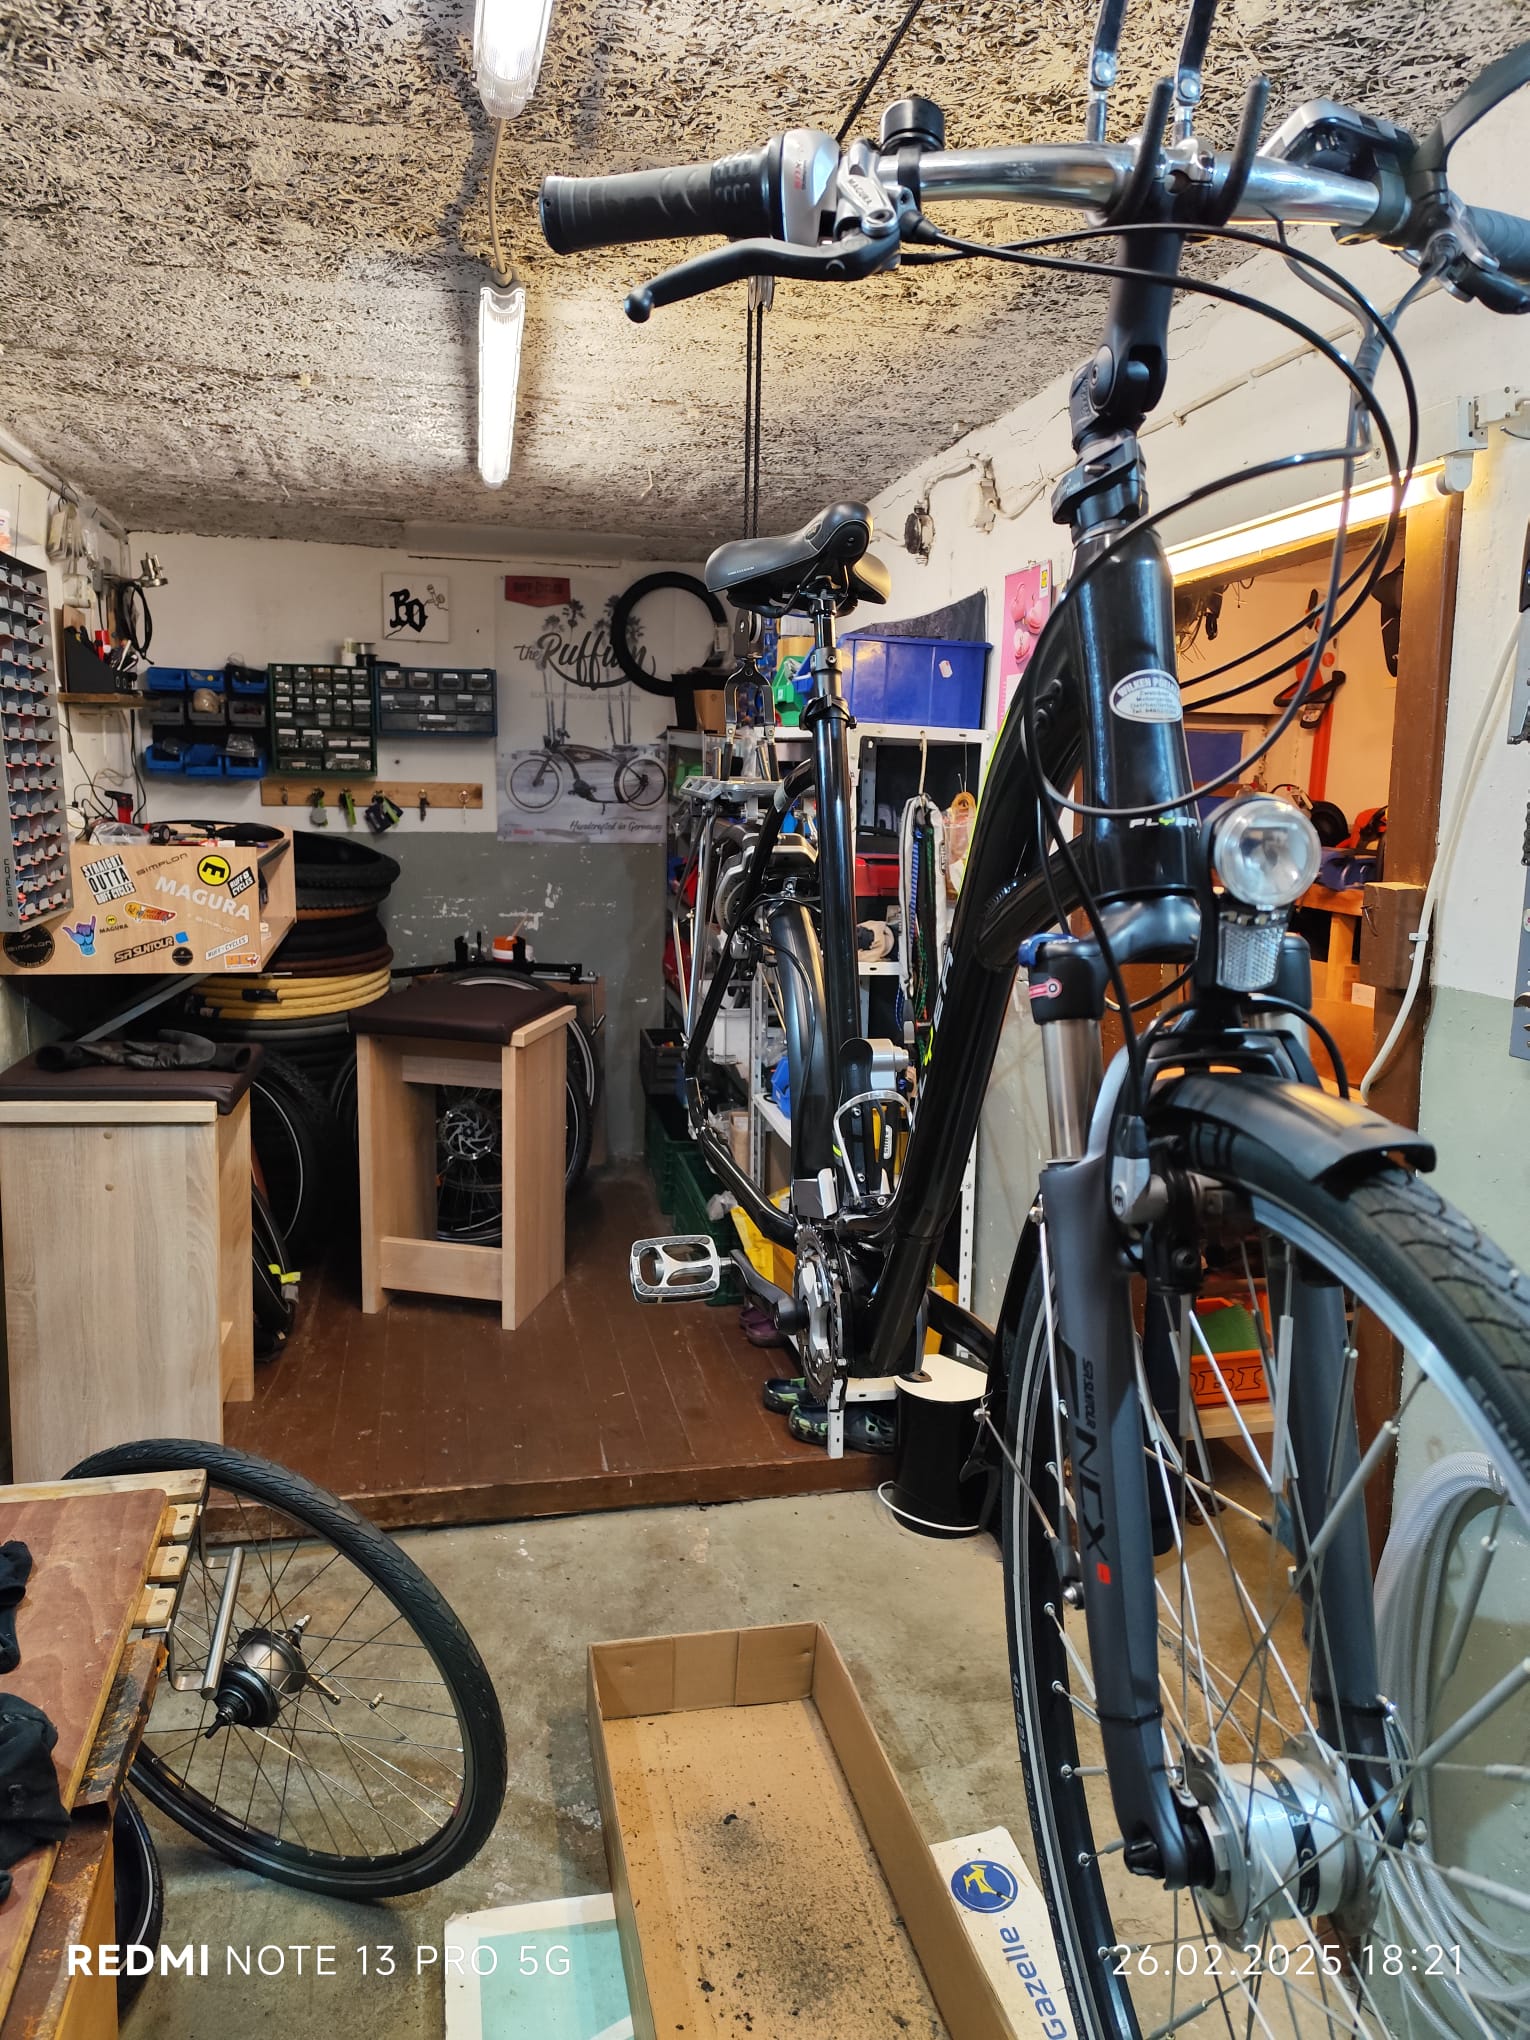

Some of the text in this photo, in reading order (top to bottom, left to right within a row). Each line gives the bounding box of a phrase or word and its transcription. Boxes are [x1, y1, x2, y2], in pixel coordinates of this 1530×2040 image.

[847, 178, 873, 206] MAGURA
[81, 854, 124, 877] STRAIGHT
[136, 852, 188, 877] SIMPLON
[3, 858, 13, 907] SIMPLON
[88, 867, 130, 893] OUTTA
[229, 870, 246, 889] RUFF
[232, 877, 254, 897] CYCLES
[155, 875, 250, 921] MAGURA
[99, 923, 129, 934] MAGURA
[132, 936, 175, 957] SUNTOUR
[1075, 1426, 1109, 1562] NCX
[999, 1926, 1069, 2040] Gazelle
